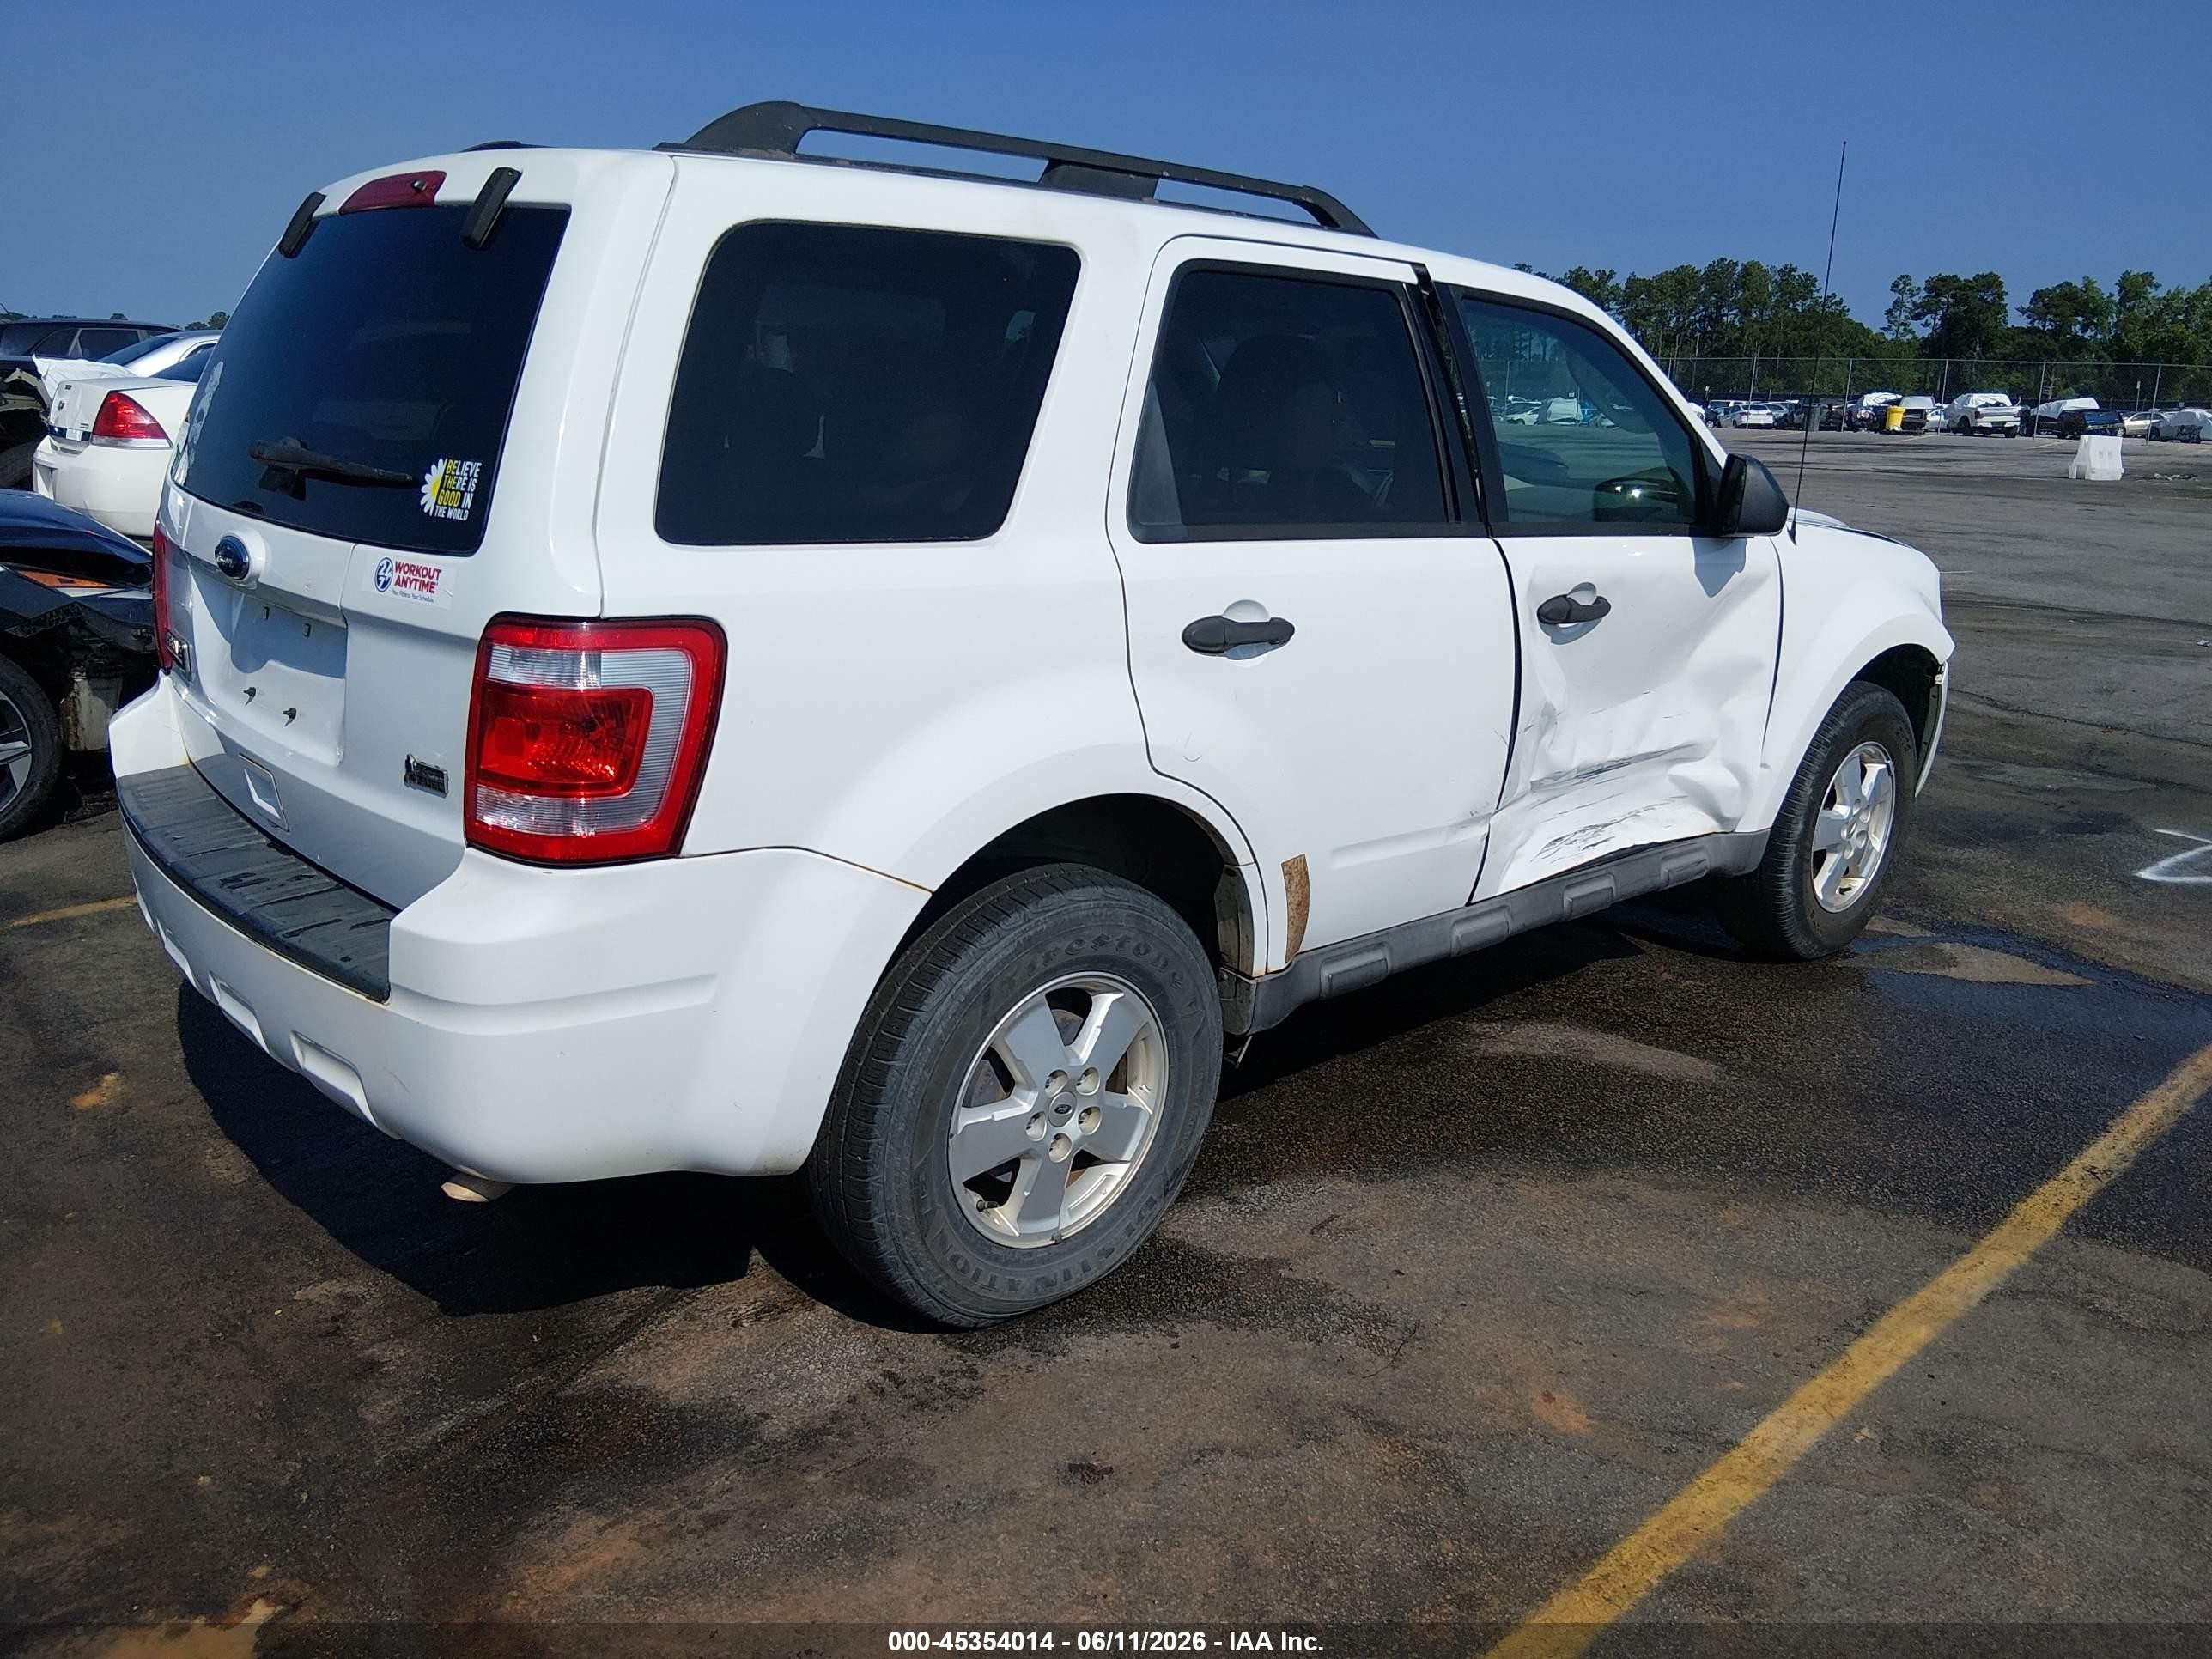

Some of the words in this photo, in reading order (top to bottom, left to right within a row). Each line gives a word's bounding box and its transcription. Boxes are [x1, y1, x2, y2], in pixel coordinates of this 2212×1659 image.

[446, 460, 482, 477] BELIEVE
[443, 476, 468, 491] THERE
[468, 478, 477, 492] IS
[438, 490, 461, 507] GOOD
[462, 493, 474, 509] IN
[435, 506, 447, 518] THE
[447, 508, 469, 521] WORLD
[394, 561, 442, 581] WORKOUT
[394, 575, 435, 594] ANYTIME
